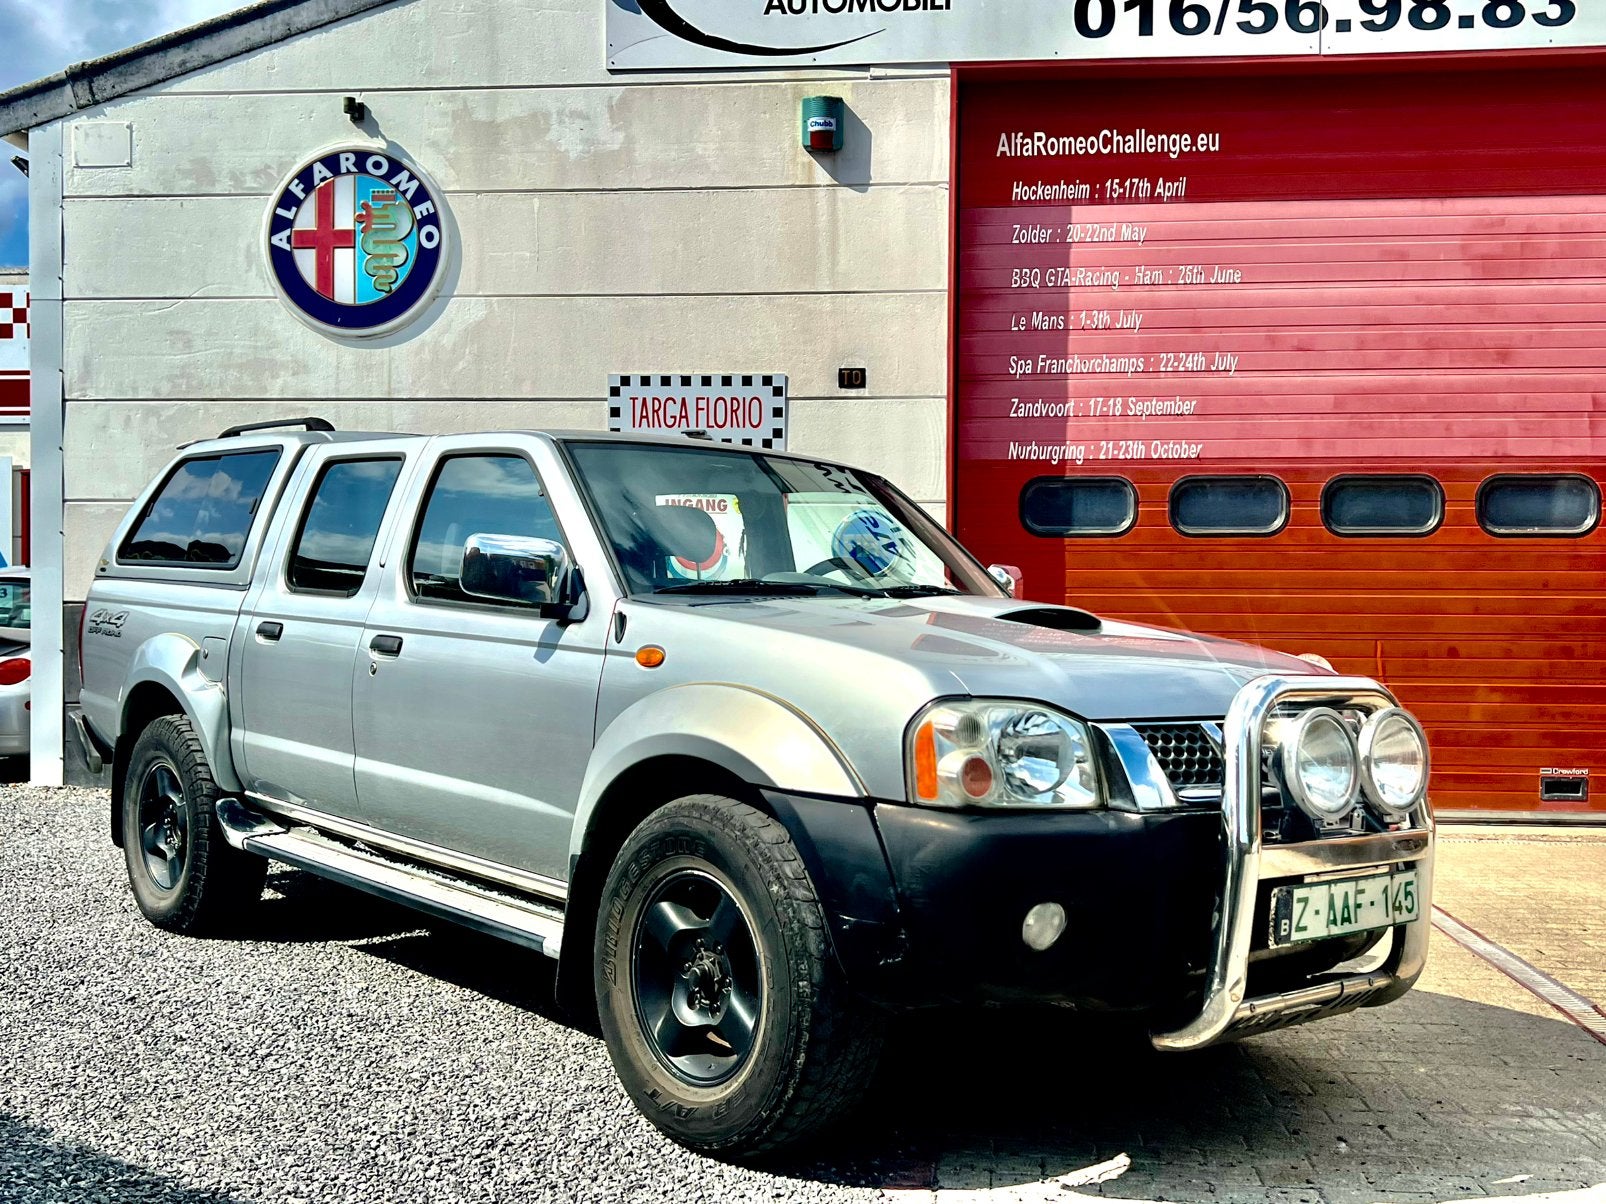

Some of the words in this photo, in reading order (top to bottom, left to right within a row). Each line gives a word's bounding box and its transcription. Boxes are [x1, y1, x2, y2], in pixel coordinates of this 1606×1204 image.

[810, 120, 834, 128] Chubb
[996, 129, 1220, 158] AlfaRomeoChallenge.eu
[1012, 179, 1090, 201] Hockenheim
[1105, 178, 1151, 199] 15-17th
[1154, 177, 1187, 201] April
[1012, 224, 1052, 243] Zolder
[1066, 223, 1116, 242] 20-22nd
[1120, 223, 1147, 246] May
[1011, 267, 1041, 288] BBQ
[1046, 266, 1120, 290] GTA-Racing
[1134, 265, 1163, 285] Ham
[1178, 265, 1205, 284] 26th
[1210, 265, 1242, 284] June
[1011, 313, 1026, 331] Le
[1031, 311, 1065, 331] Mans
[1080, 310, 1111, 331] 1-3th
[1115, 309, 1143, 333] July
[1008, 356, 1032, 379] Spa
[1037, 354, 1144, 377] Franchorchamps
[1159, 352, 1206, 372] 22-24th
[1210, 352, 1239, 376] July
[630, 396, 690, 429] TARGA
[695, 396, 763, 429] FLORIO
[1009, 398, 1075, 418] Zandvoort
[1089, 397, 1122, 417] 17-18
[1127, 396, 1197, 421] September
[1008, 441, 1085, 465] Nurburgring
[1099, 440, 1146, 460] 21-23th
[1150, 440, 1203, 460] October
[89, 608, 130, 628] 4x4
[1280, 919, 1290, 936] B
